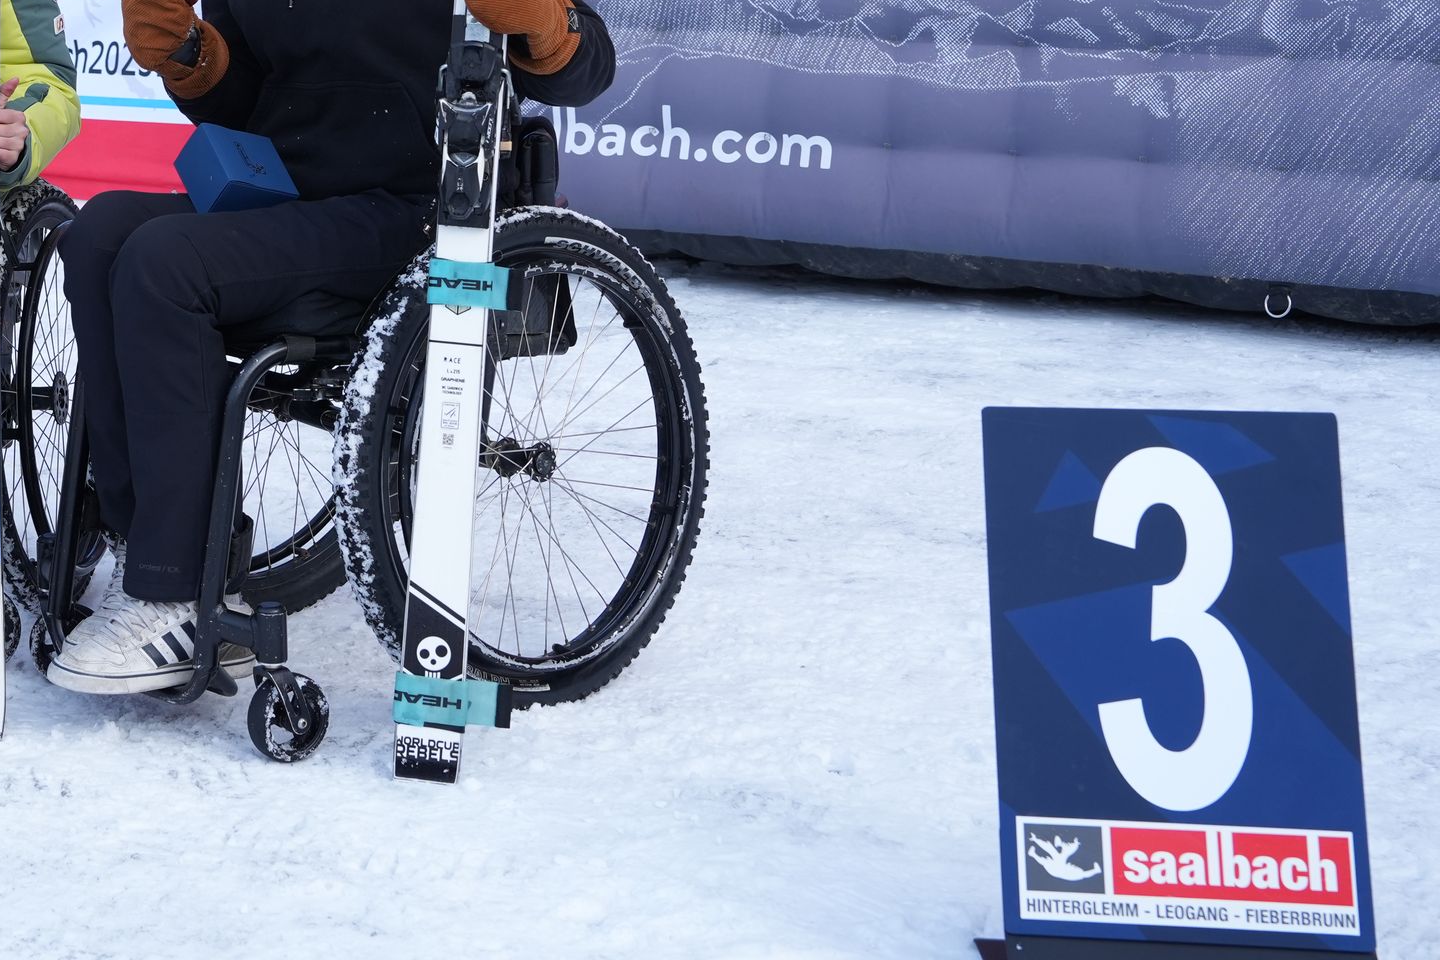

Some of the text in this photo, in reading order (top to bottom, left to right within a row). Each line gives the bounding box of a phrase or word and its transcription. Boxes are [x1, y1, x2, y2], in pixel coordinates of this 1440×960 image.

[428, 276, 494, 292] HEAD
[1092, 446, 1253, 811] 3
[1122, 828, 1339, 892] saalbach
[1026, 898, 1139, 918] HINTERGLEMM
[1156, 904, 1229, 922] LEOGANG
[1246, 909, 1356, 929] FIEBERBRUNN
